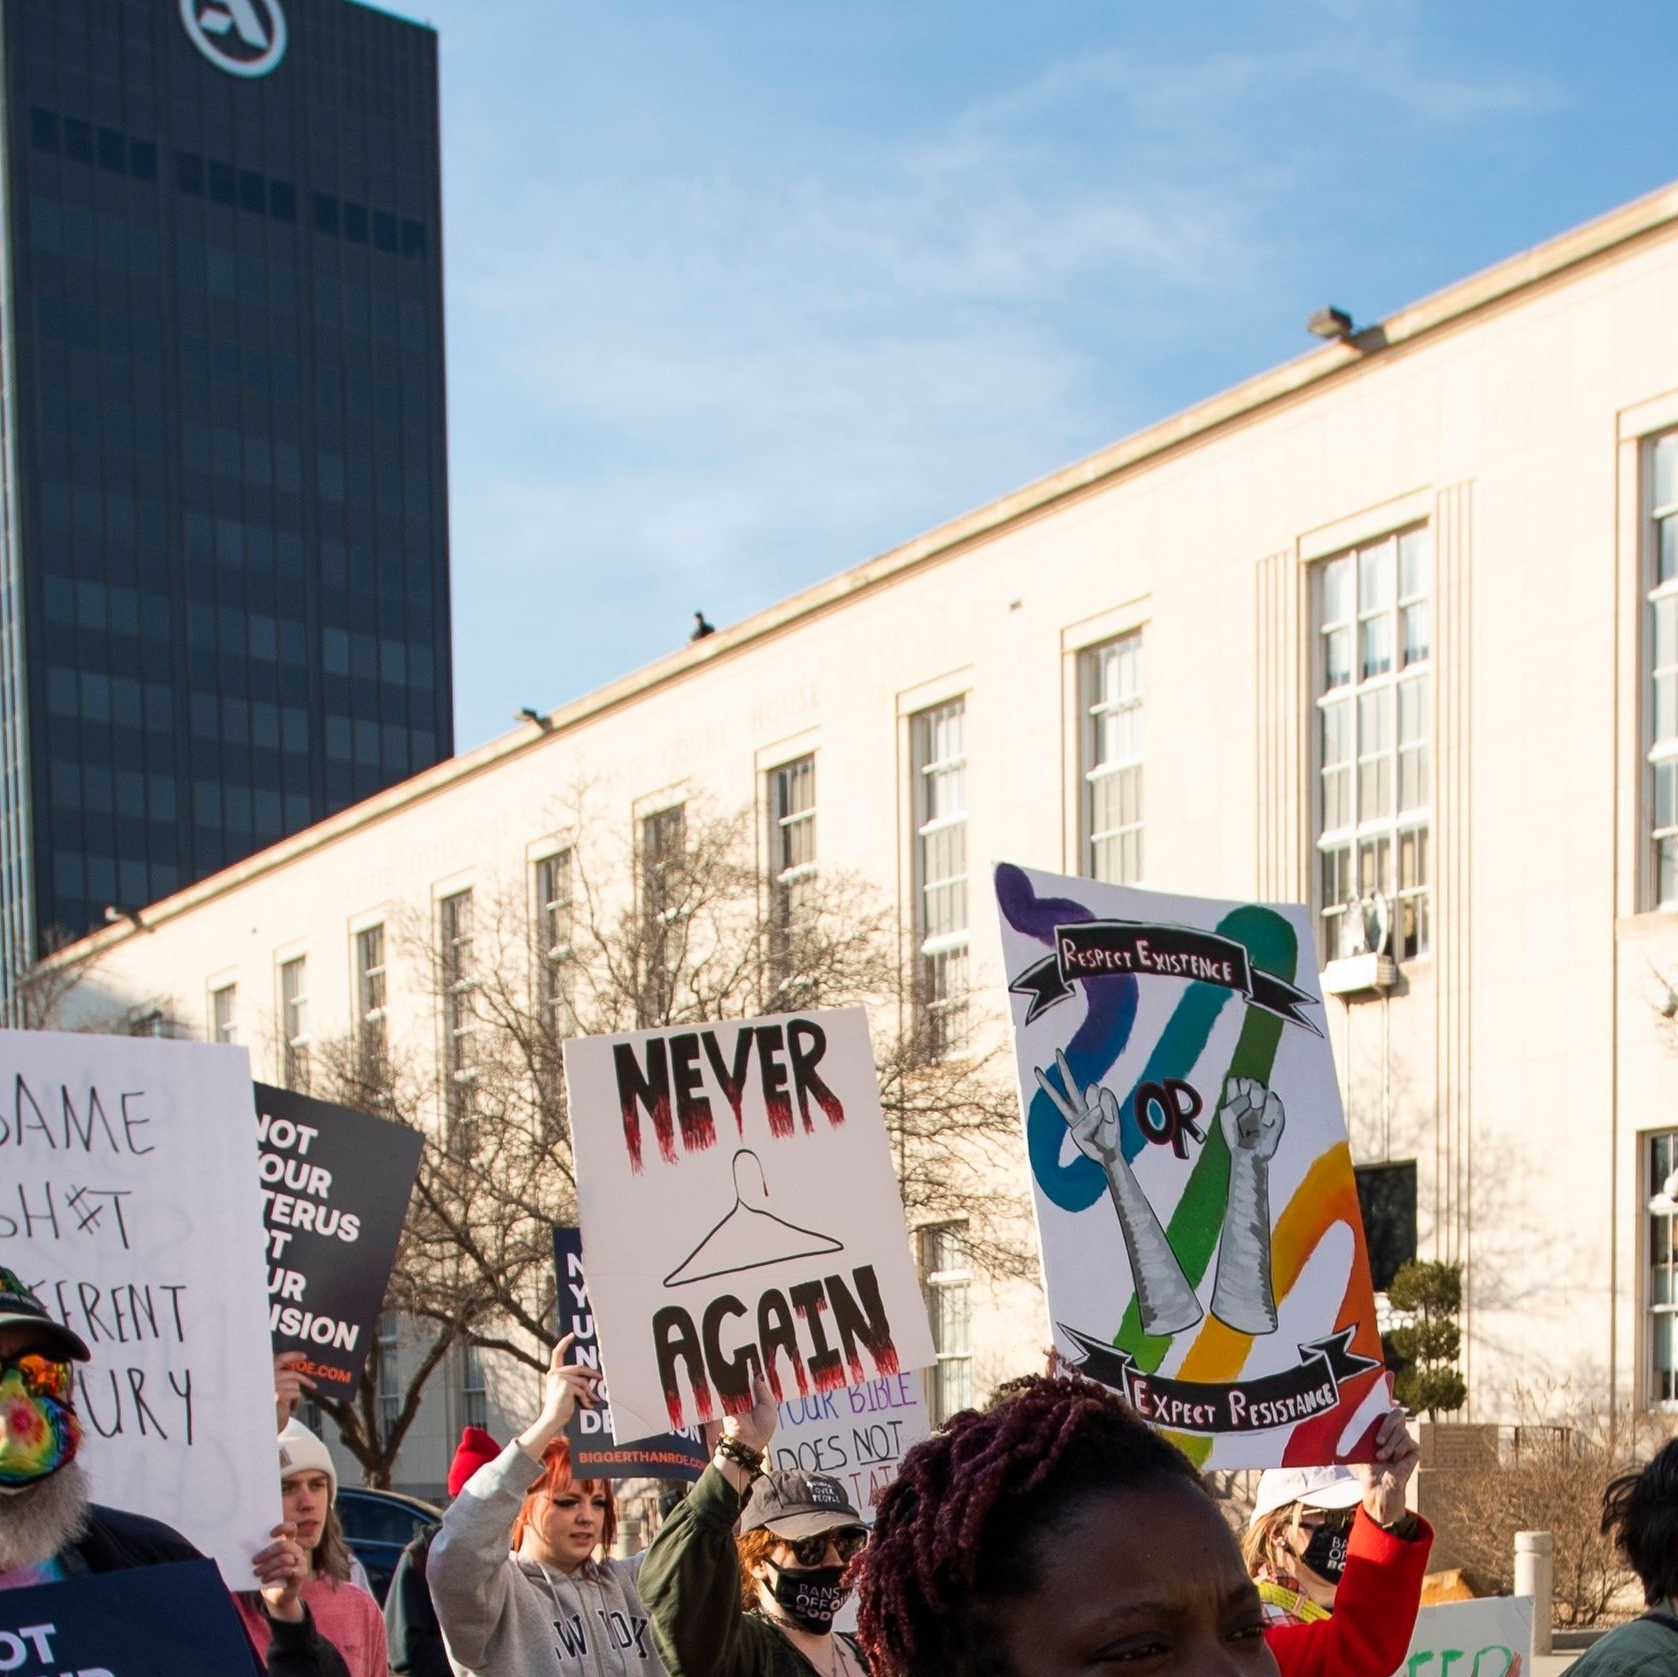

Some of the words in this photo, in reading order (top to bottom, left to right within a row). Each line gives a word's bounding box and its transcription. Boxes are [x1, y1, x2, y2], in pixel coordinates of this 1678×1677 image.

[1062, 937, 1133, 971] RESPECT
[1135, 939, 1233, 982] EXISTENCE
[613, 1018, 846, 1176] NEVER
[1134, 1077, 1206, 1161] OR
[257, 1152, 333, 1200] OUR
[261, 1187, 362, 1244] TERUS
[652, 1265, 900, 1432] AGAIN
[77, 1367, 194, 1447] URY
[847, 1371, 917, 1414] BIBLE
[1132, 1378, 1216, 1424] EXPECT
[1228, 1382, 1334, 1426] RESISTANCE
[776, 1435, 848, 1473] DOES
[852, 1420, 903, 1463] NOT
[796, 1594, 829, 1610] OFF
[799, 1583, 841, 1600] BANS
